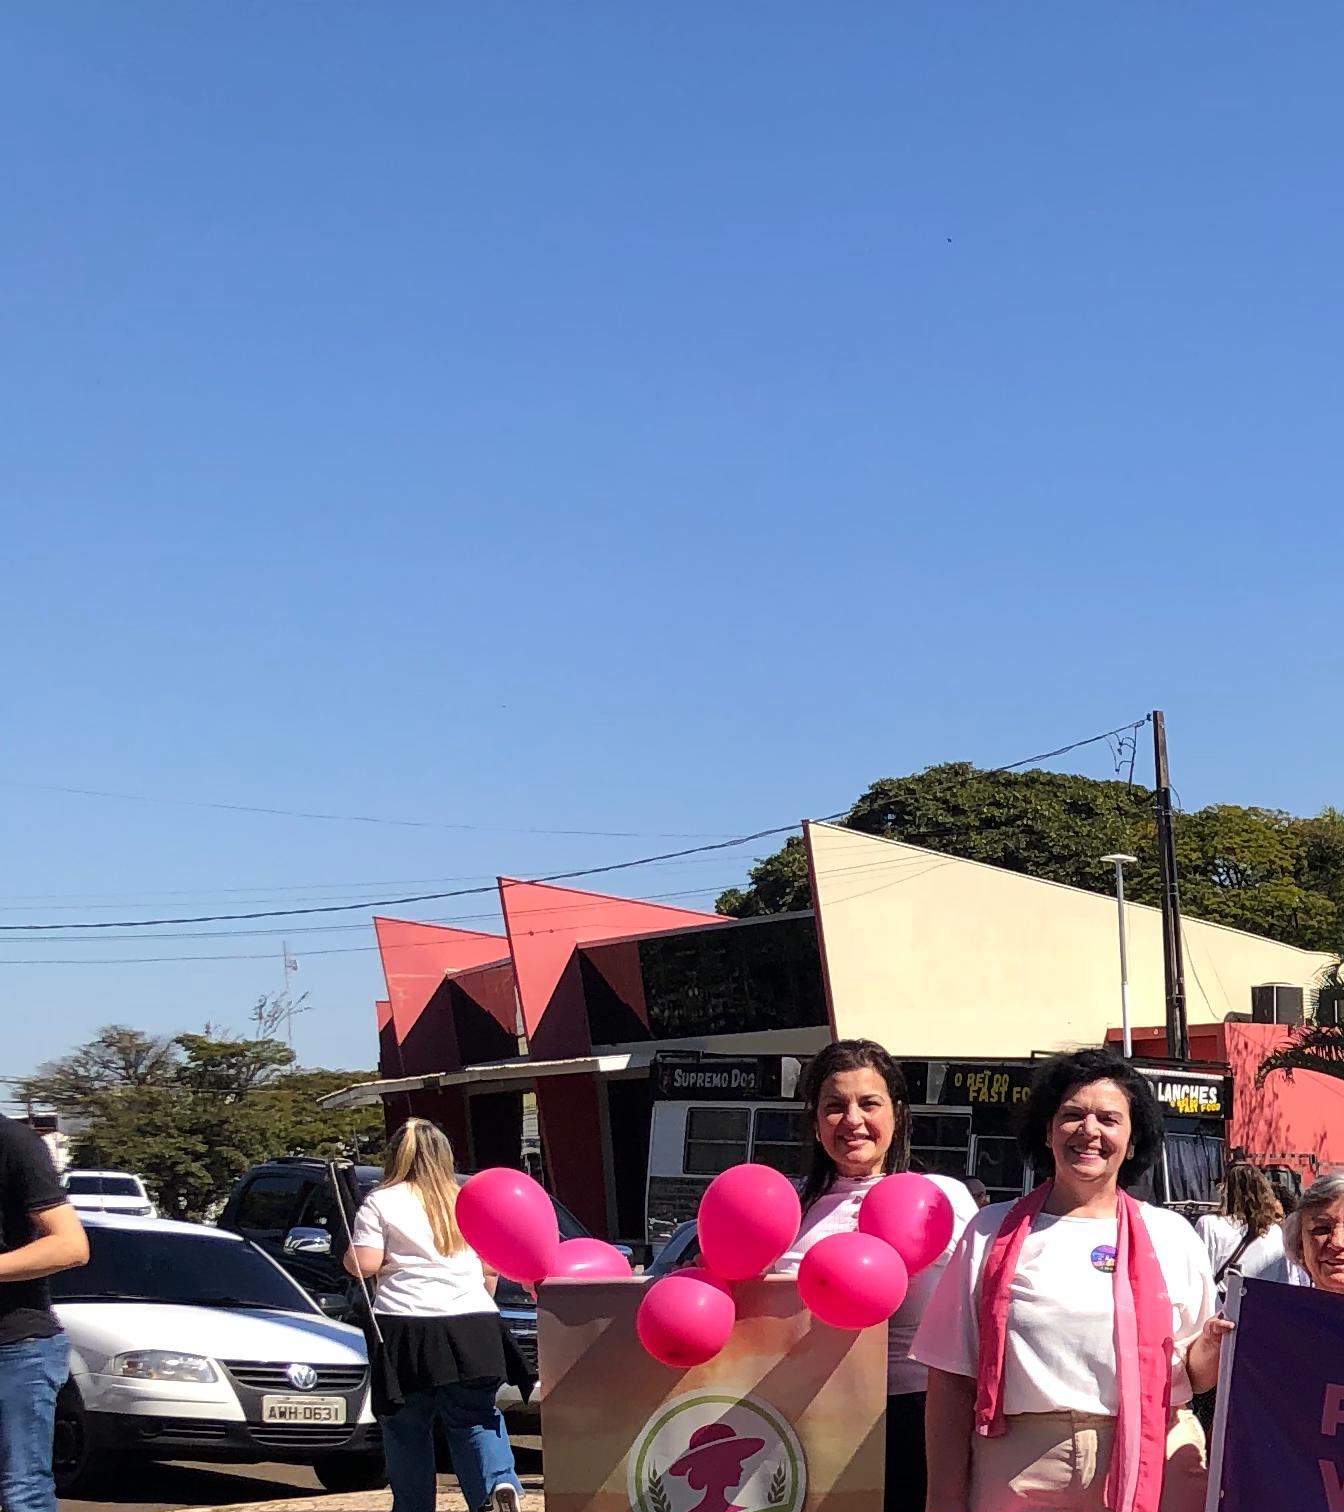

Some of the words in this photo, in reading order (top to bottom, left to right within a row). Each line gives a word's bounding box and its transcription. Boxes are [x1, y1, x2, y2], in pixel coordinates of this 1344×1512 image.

[969, 1087, 1005, 1102] FAST
[1013, 1087, 1031, 1104] FO
[1158, 1082, 1217, 1104] LANCHES
